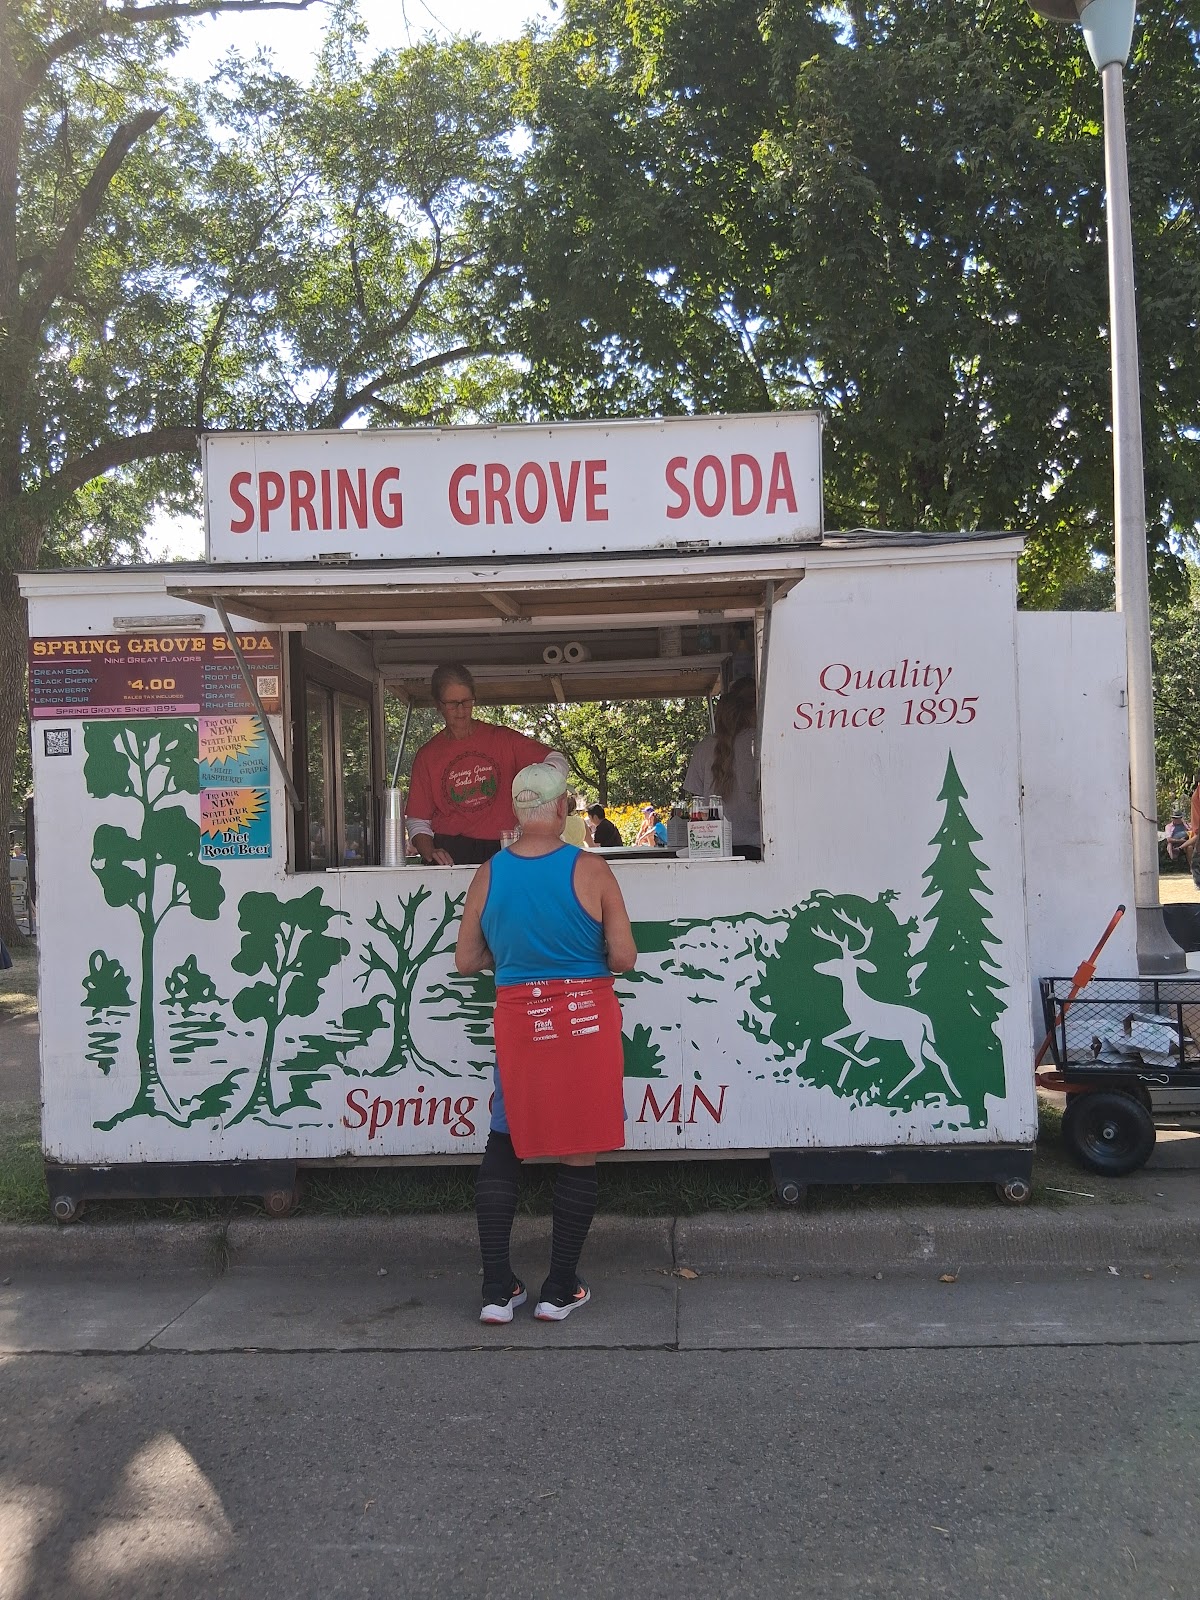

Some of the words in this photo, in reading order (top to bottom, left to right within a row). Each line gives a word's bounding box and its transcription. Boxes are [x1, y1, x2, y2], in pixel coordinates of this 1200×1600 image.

[229, 466, 403, 534] SPRING
[448, 459, 610, 526] GROVE
[665, 451, 798, 520] SODA
[33, 640, 121, 656] SPRING
[127, 637, 206, 653] GROVE
[212, 635, 274, 651] SODA
[127, 656, 158, 664] GREAT
[160, 655, 202, 663] FLAVORS
[819, 658, 953, 697] Quality
[793, 701, 886, 730] Since
[900, 695, 980, 725] 1895
[210, 725, 234, 736] NEW
[201, 737, 225, 746] STATE
[227, 734, 247, 743] FAIR
[208, 743, 242, 753] FLAVORS
[242, 759, 264, 767] SOUR
[240, 766, 268, 774] GRAPES
[449, 770, 472, 781] Spring
[474, 764, 493, 774] Grove
[455, 776, 473, 788] Soda
[474, 774, 487, 783] Pop
[212, 798, 235, 809] NEW
[202, 811, 226, 819] STATE
[229, 807, 249, 815] FAIR
[212, 816, 242, 826] FLAVOR
[223, 832, 249, 843] Diet
[203, 844, 235, 858] Root
[238, 844, 270, 855] Beer
[534, 1019, 552, 1028] Fresh
[343, 1085, 479, 1140] Spring
[635, 1083, 730, 1124] MN
